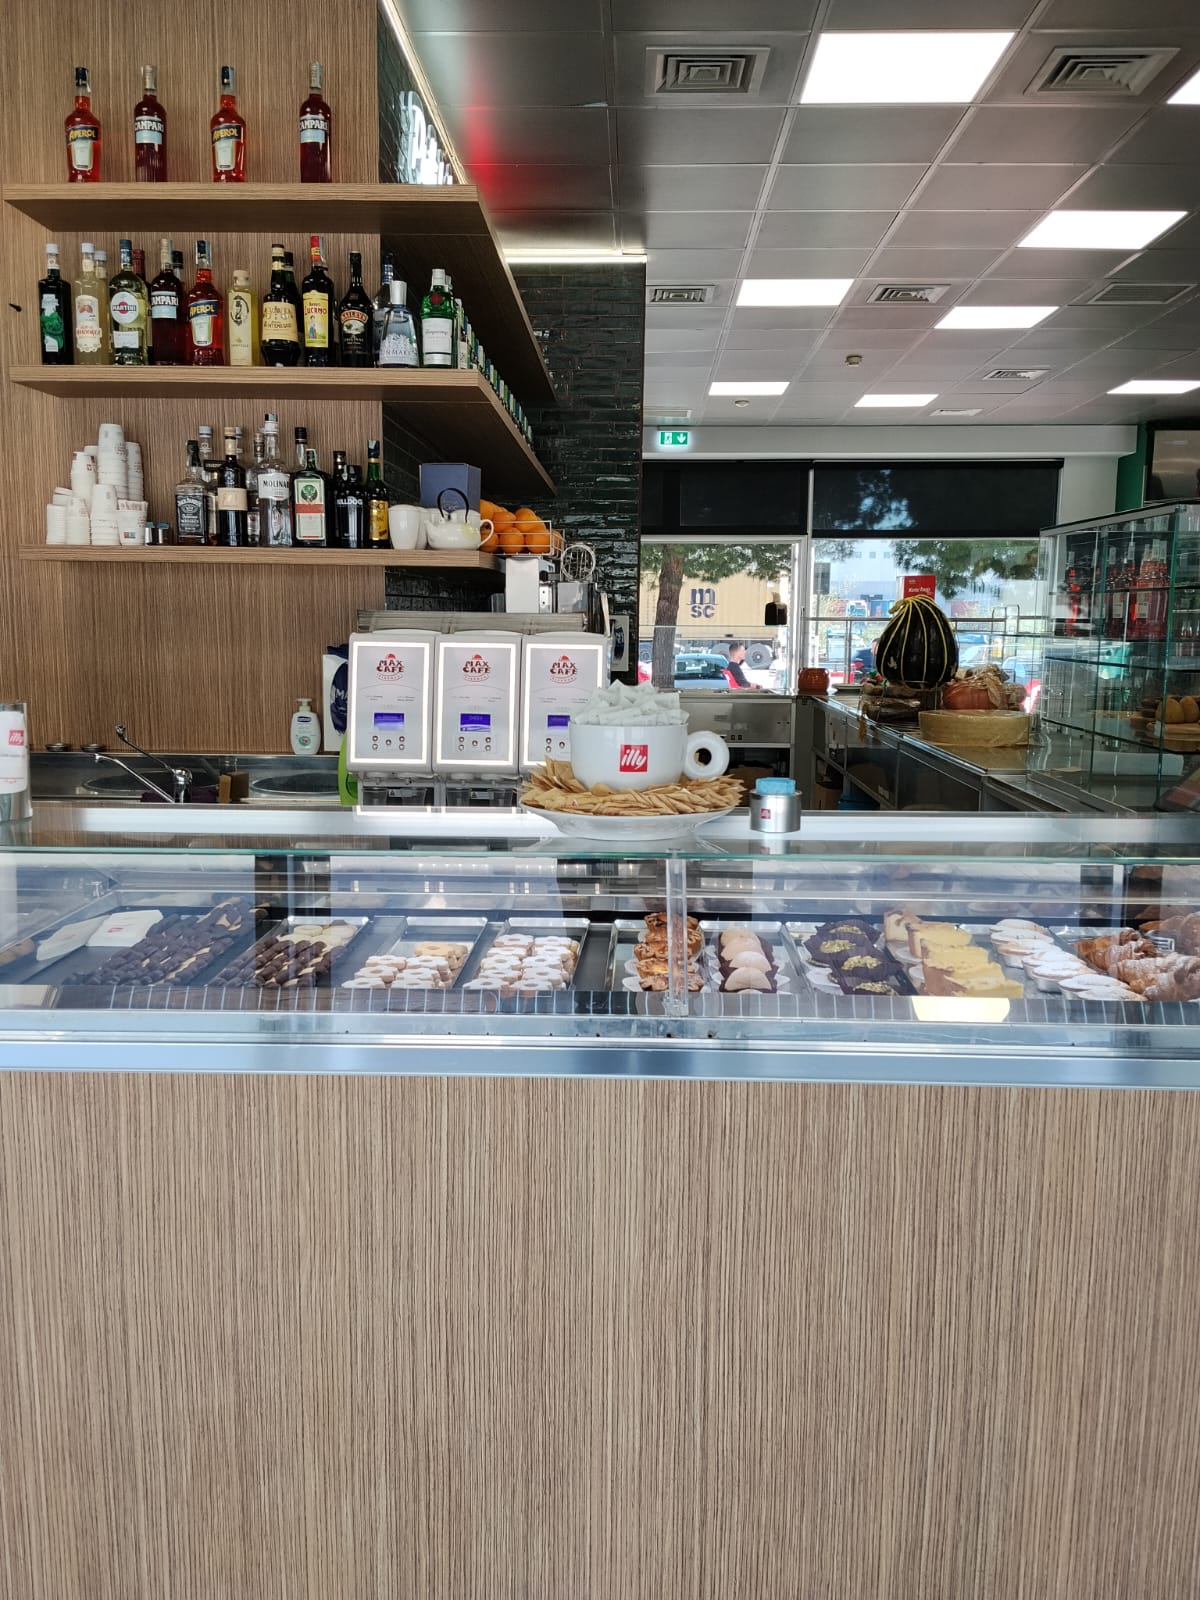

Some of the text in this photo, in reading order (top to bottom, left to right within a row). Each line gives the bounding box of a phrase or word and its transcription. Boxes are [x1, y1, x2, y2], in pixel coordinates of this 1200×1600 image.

[69, 129, 96, 141] APEROL
[213, 128, 239, 141] APEROL
[152, 295, 179, 306] AMPARI
[112, 304, 137, 312] MARTINI
[189, 304, 216, 317] APEROL
[621, 748, 647, 770] illy
